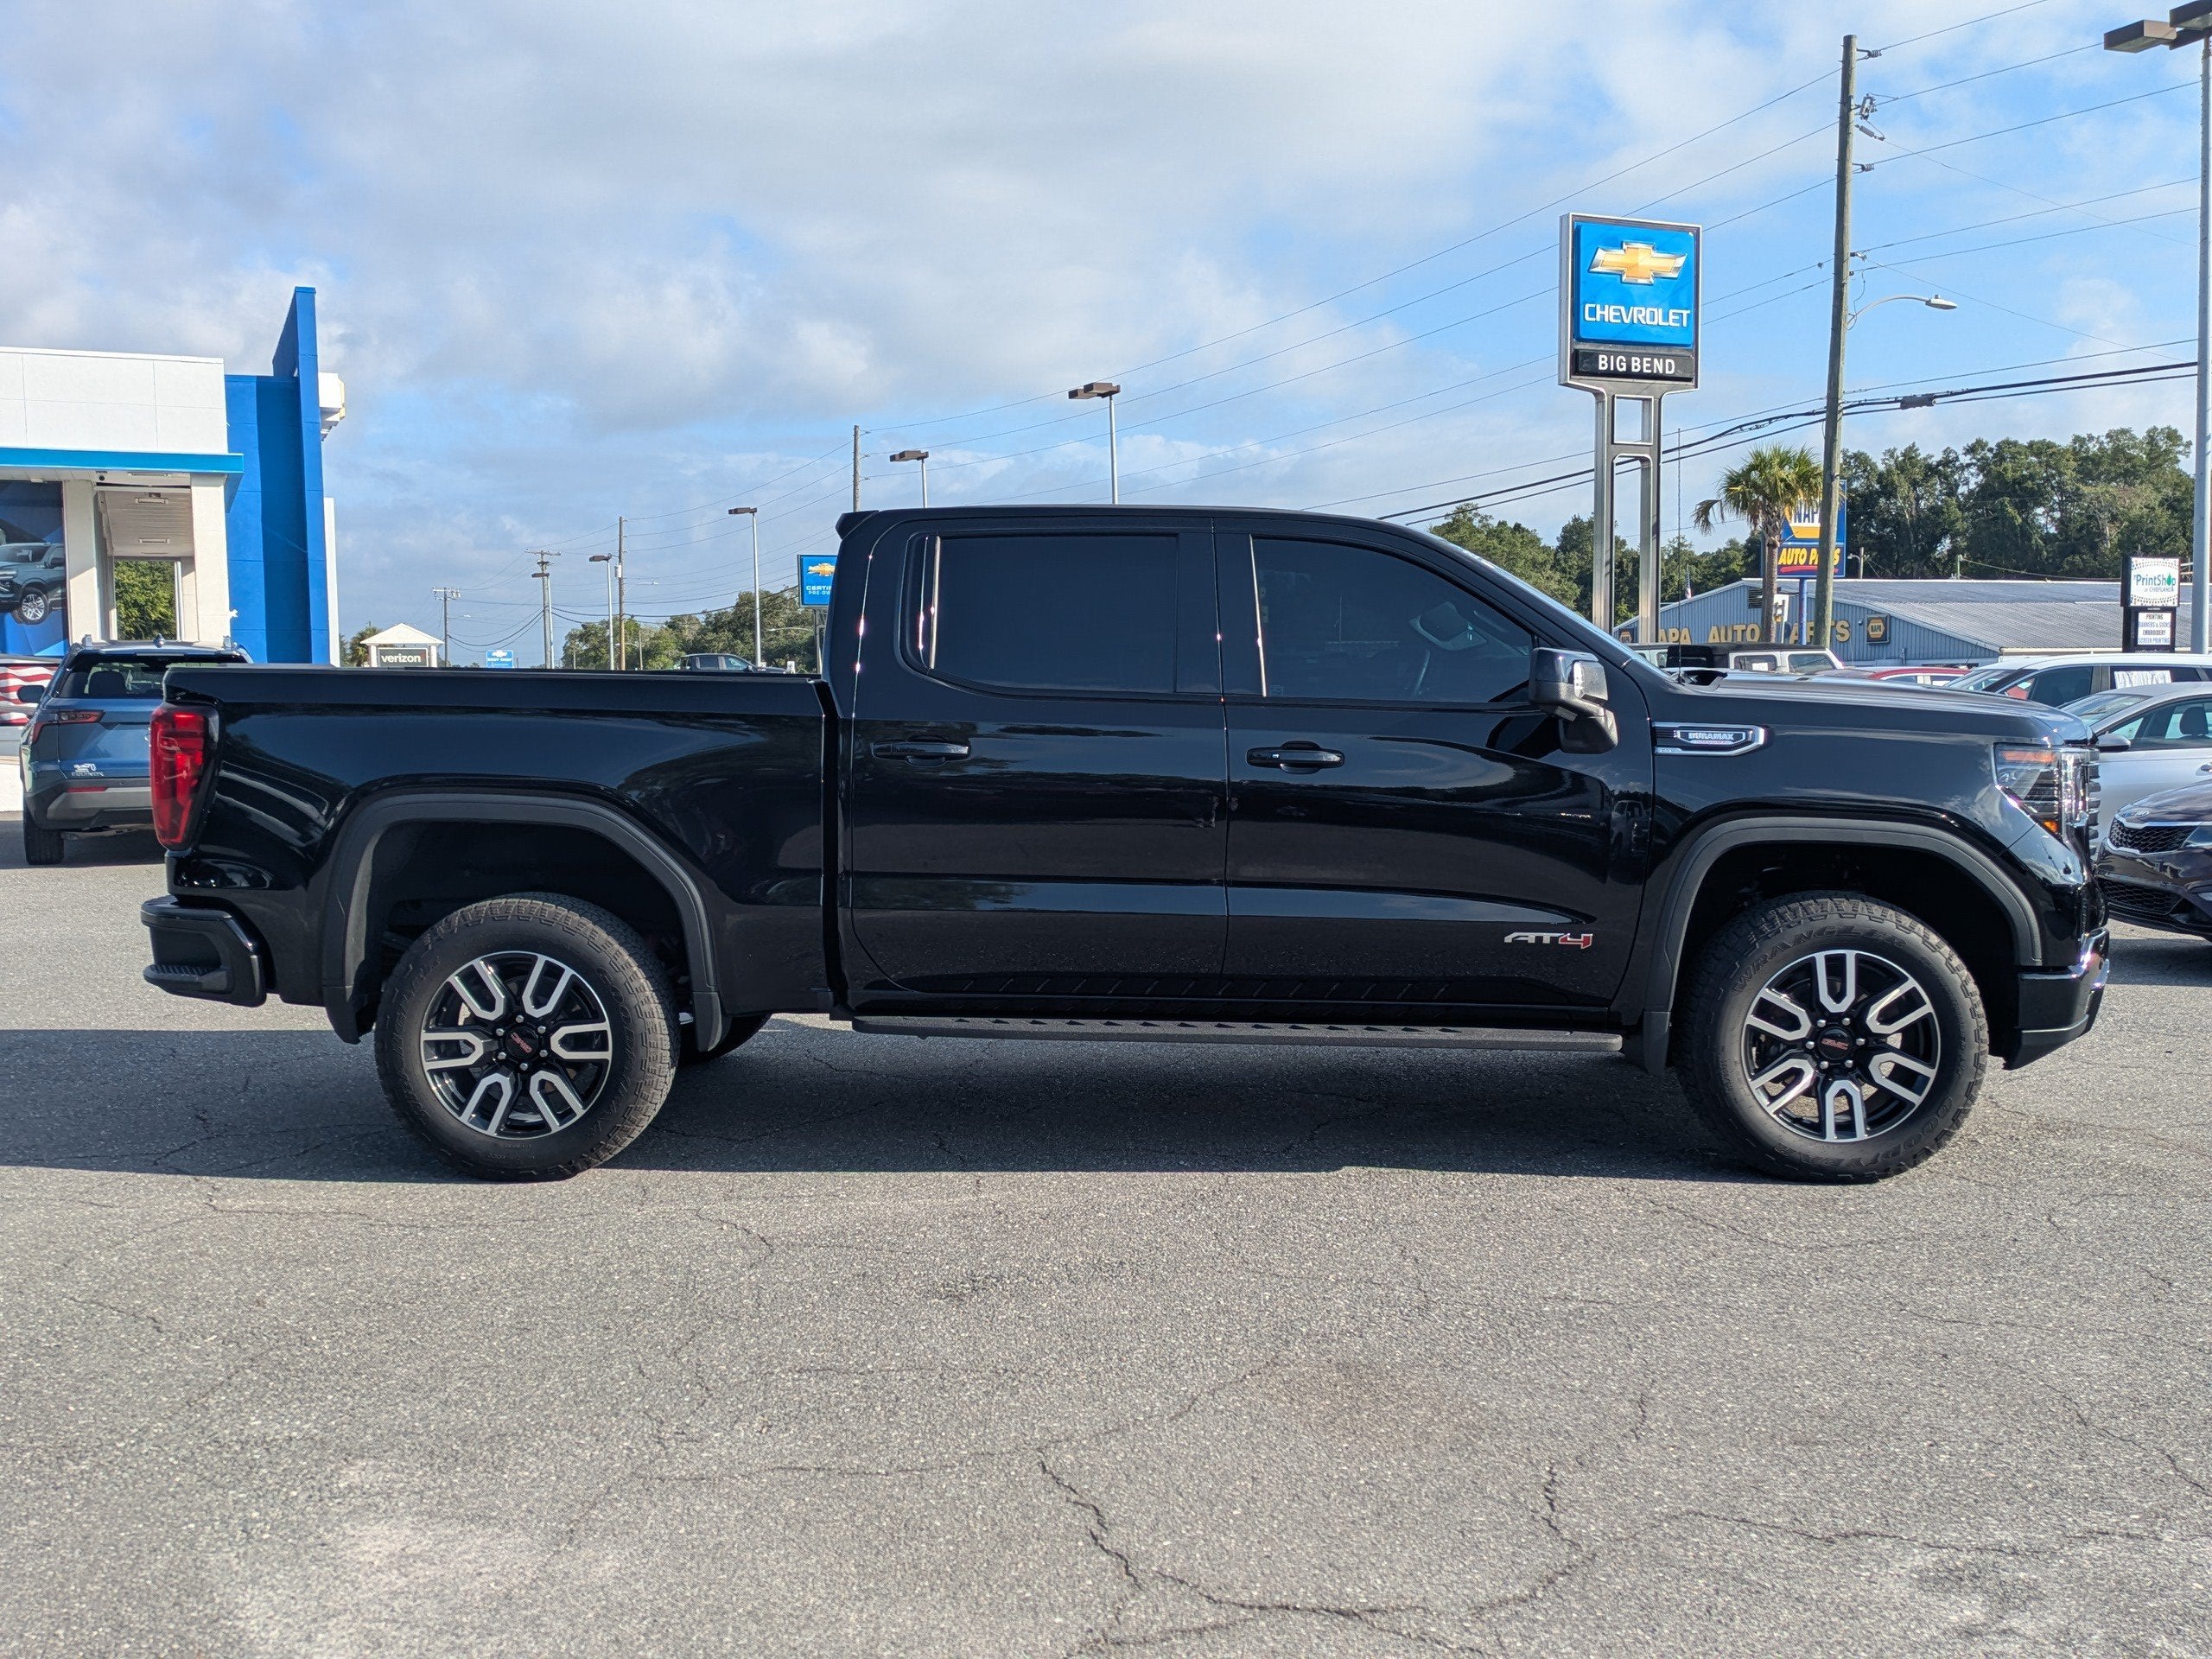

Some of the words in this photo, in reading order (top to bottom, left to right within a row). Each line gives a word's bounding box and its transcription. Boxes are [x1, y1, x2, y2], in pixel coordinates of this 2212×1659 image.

[1584, 303, 1691, 327] CHEVROLET
[1598, 354, 1627, 372] BIG
[1630, 357, 1675, 375] BEND
[1777, 547, 1808, 566] AUTO
[1658, 627, 1692, 645] APA
[1707, 623, 1761, 643] AUTO
[380, 653, 422, 664] verizon
[1688, 732, 1735, 741] DURAMAX
[1503, 931, 1593, 950] AT4
[510, 1031, 533, 1054] GMC
[1821, 1038, 1849, 1051] GMC
